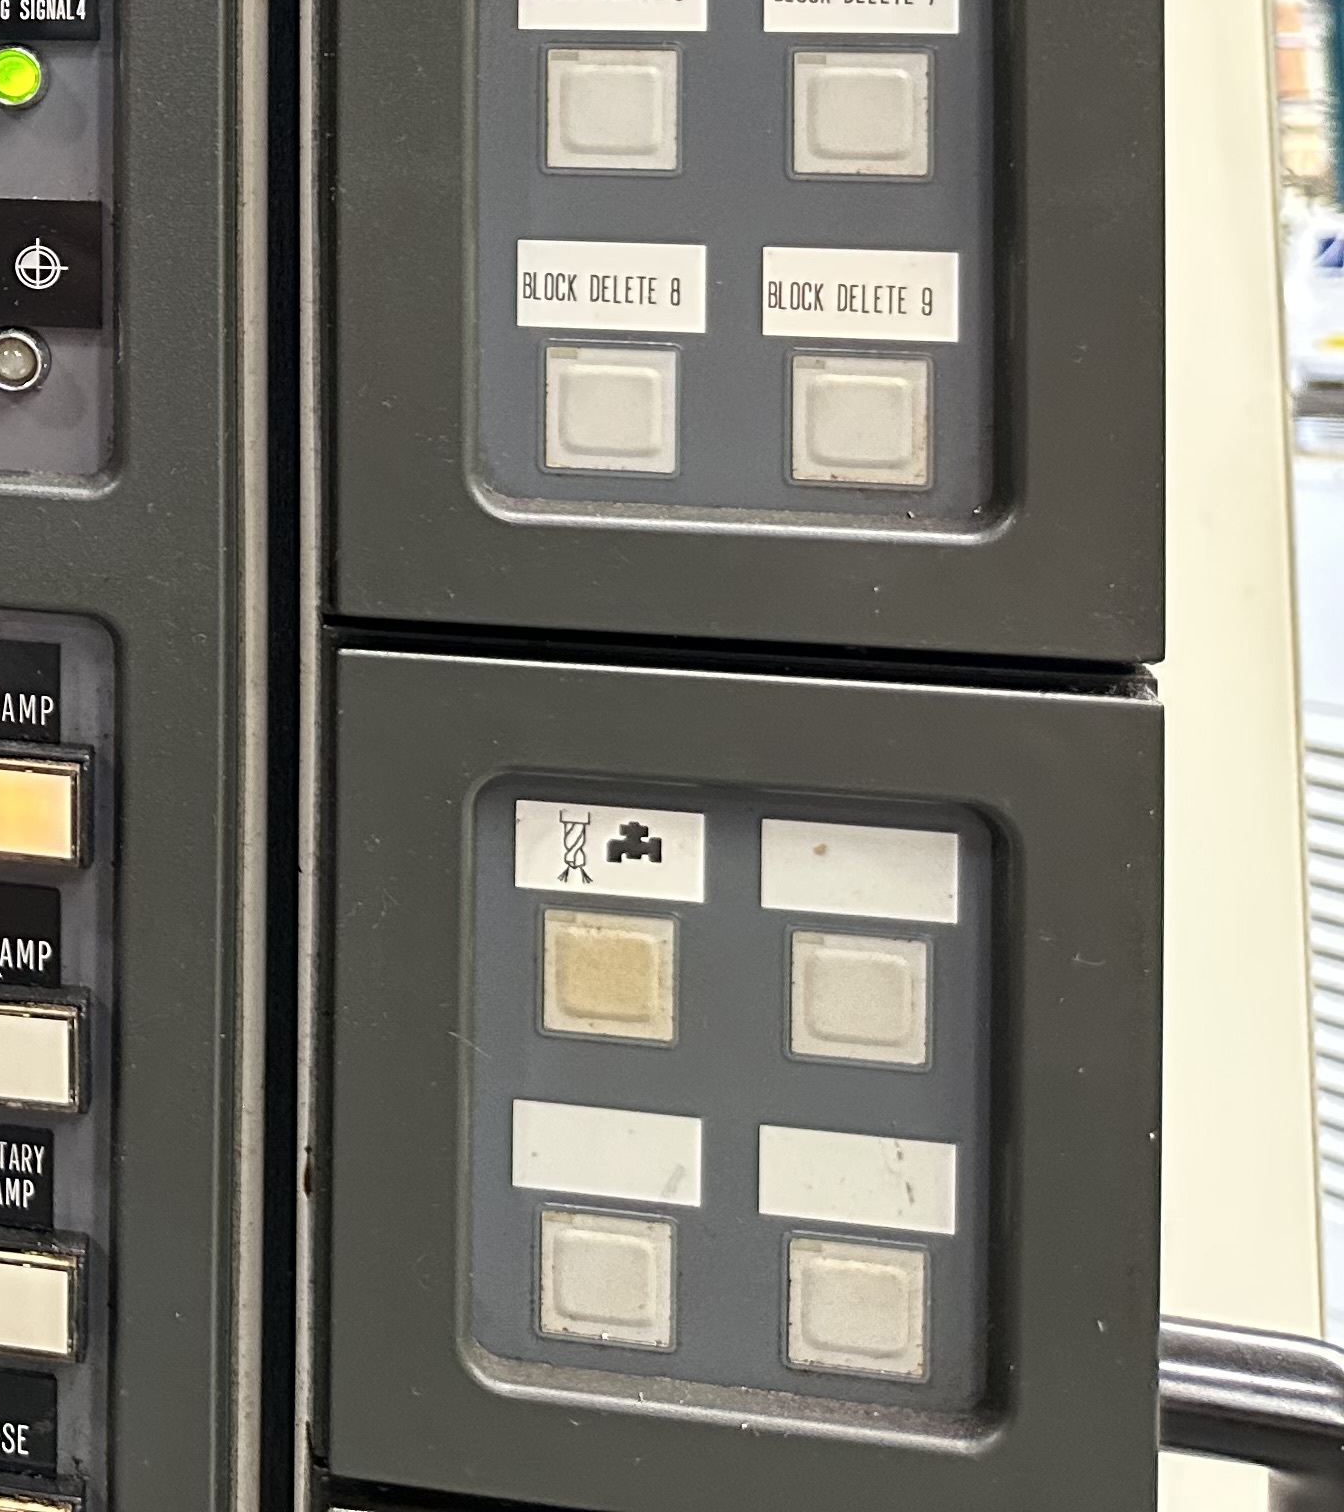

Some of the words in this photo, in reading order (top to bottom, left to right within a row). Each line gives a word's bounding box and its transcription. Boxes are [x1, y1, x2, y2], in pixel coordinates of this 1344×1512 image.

[19, 0, 86, 21] SIGNAL4
[523, 272, 577, 302] BLOCK
[590, 275, 657, 305] DELETE
[670, 278, 681, 306] 8
[768, 282, 824, 312] BLOCK
[837, 284, 907, 315] DELETE
[920, 288, 932, 316] 9
